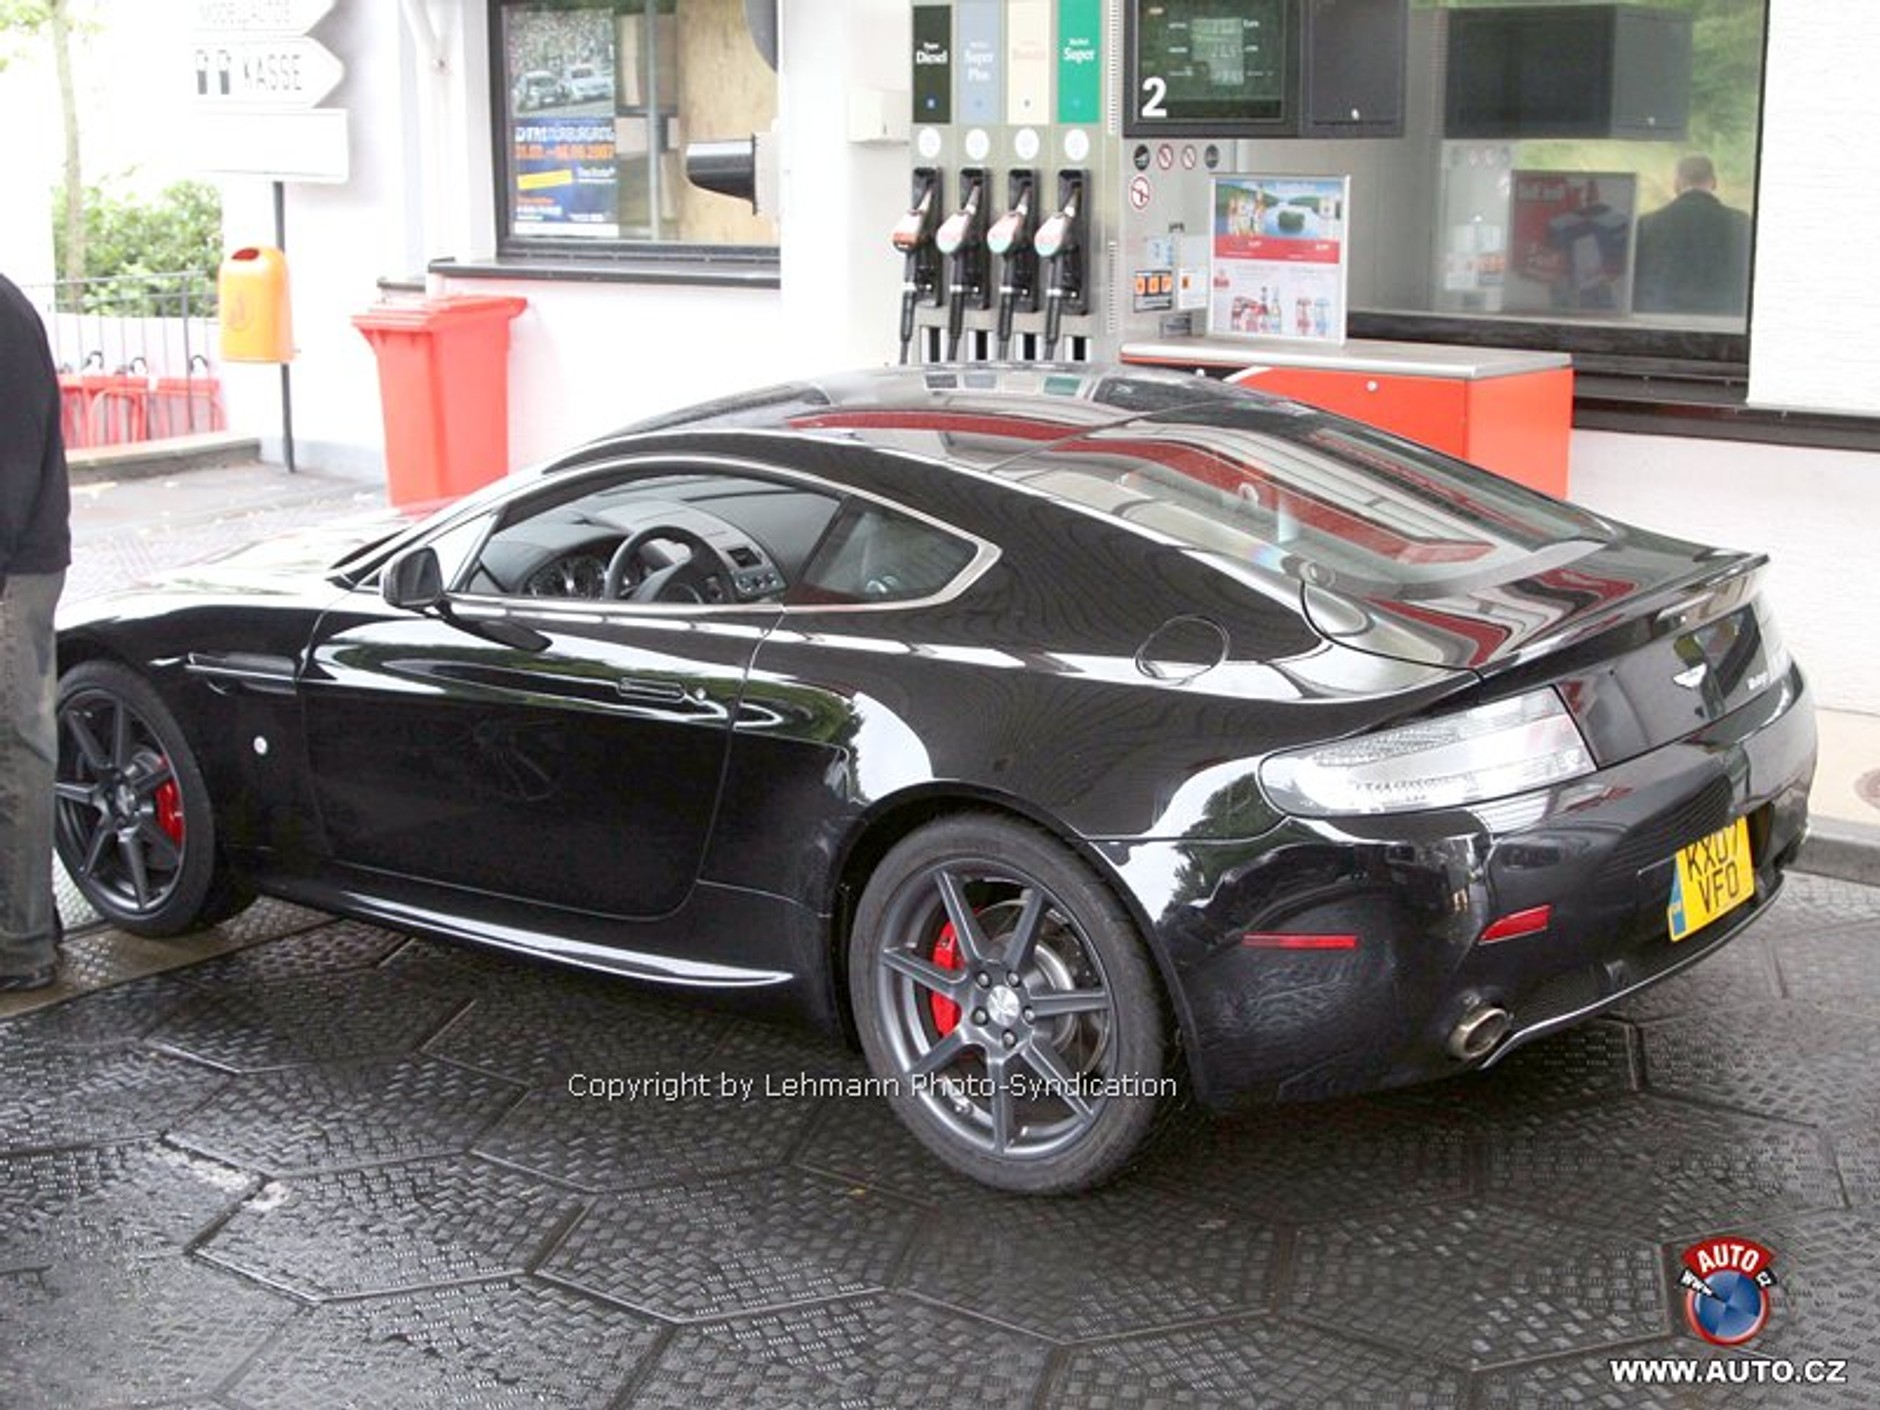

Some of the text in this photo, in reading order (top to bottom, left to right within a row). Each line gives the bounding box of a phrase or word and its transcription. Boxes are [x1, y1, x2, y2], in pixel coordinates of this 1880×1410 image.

[916, 50, 948, 65] Diesel
[1063, 46, 1095, 64] Super
[243, 53, 302, 91] KASSE
[1141, 76, 1168, 118] 2
